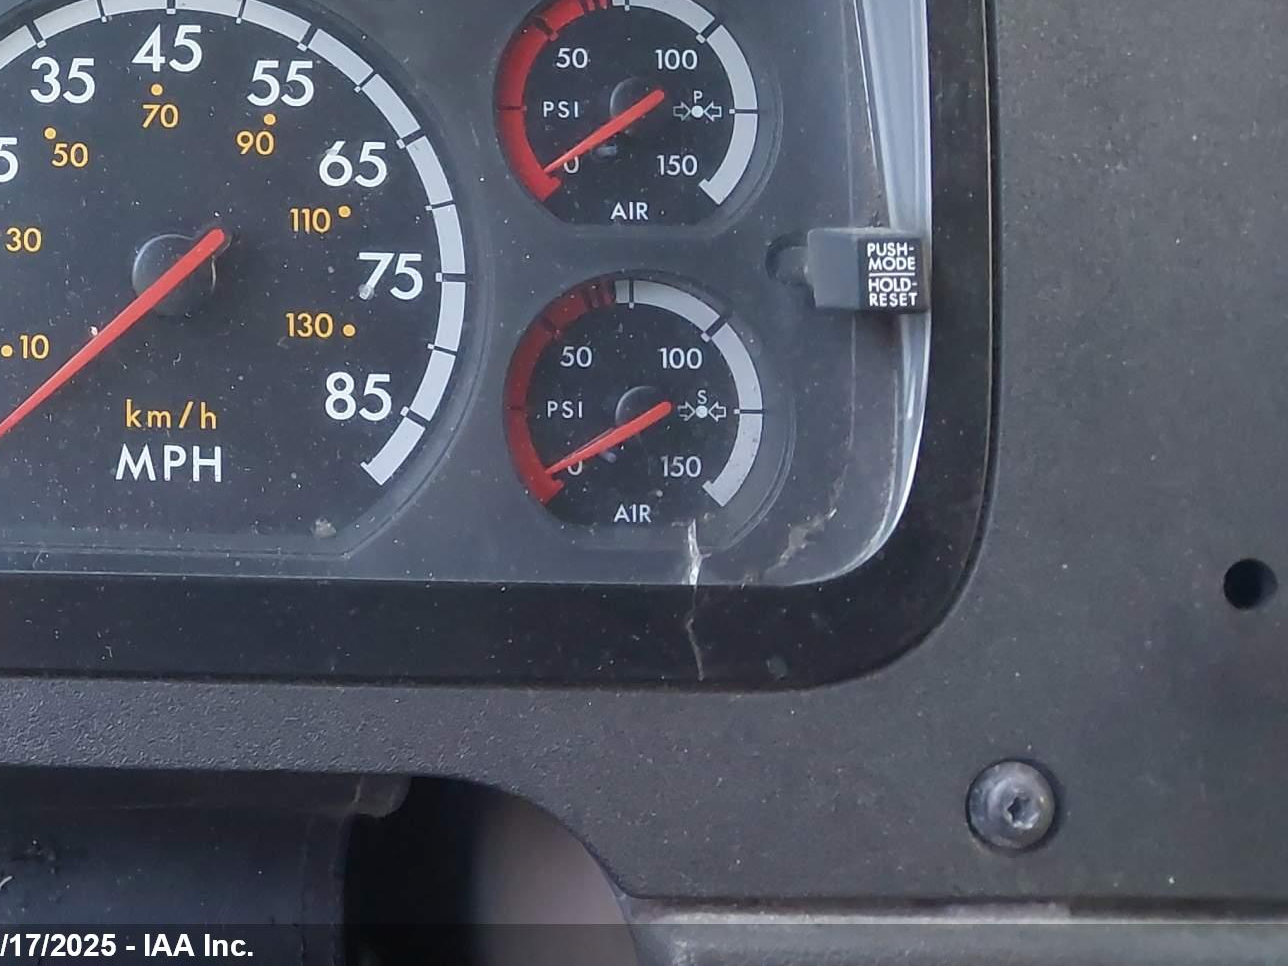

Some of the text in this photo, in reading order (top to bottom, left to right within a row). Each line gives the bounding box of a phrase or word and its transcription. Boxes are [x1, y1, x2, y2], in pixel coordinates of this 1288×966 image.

[132, 24, 203, 72] 45
[556, 48, 588, 69] 50
[655, 49, 699, 70] 100
[30, 56, 95, 104] 35
[247, 60, 314, 107] 55
[693, 90, 704, 104] P
[142, 104, 180, 129] 70
[542, 101, 580, 118] PSI
[236, 131, 275, 156] 90
[51, 143, 89, 168] 50
[318, 141, 387, 187] 65
[657, 155, 698, 176] 150
[290, 208, 331, 233] 110
[610, 201, 649, 221] AIR
[5, 228, 42, 252] 30
[867, 242, 914, 257] PUSH-
[868, 257, 916, 271] MODE
[357, 253, 423, 300] 75
[868, 277, 918, 292] HOLD-
[869, 292, 918, 307] RESET
[286, 313, 333, 338] 130
[19, 335, 50, 360] 10
[560, 347, 593, 368] 50
[659, 348, 703, 369] 100
[324, 373, 392, 421] 85
[697, 389, 708, 404] S
[125, 399, 217, 429] km/h
[546, 401, 585, 419] PSI
[115, 445, 222, 483] MPH
[660, 456, 702, 478] 150
[613, 504, 652, 524] AIR
